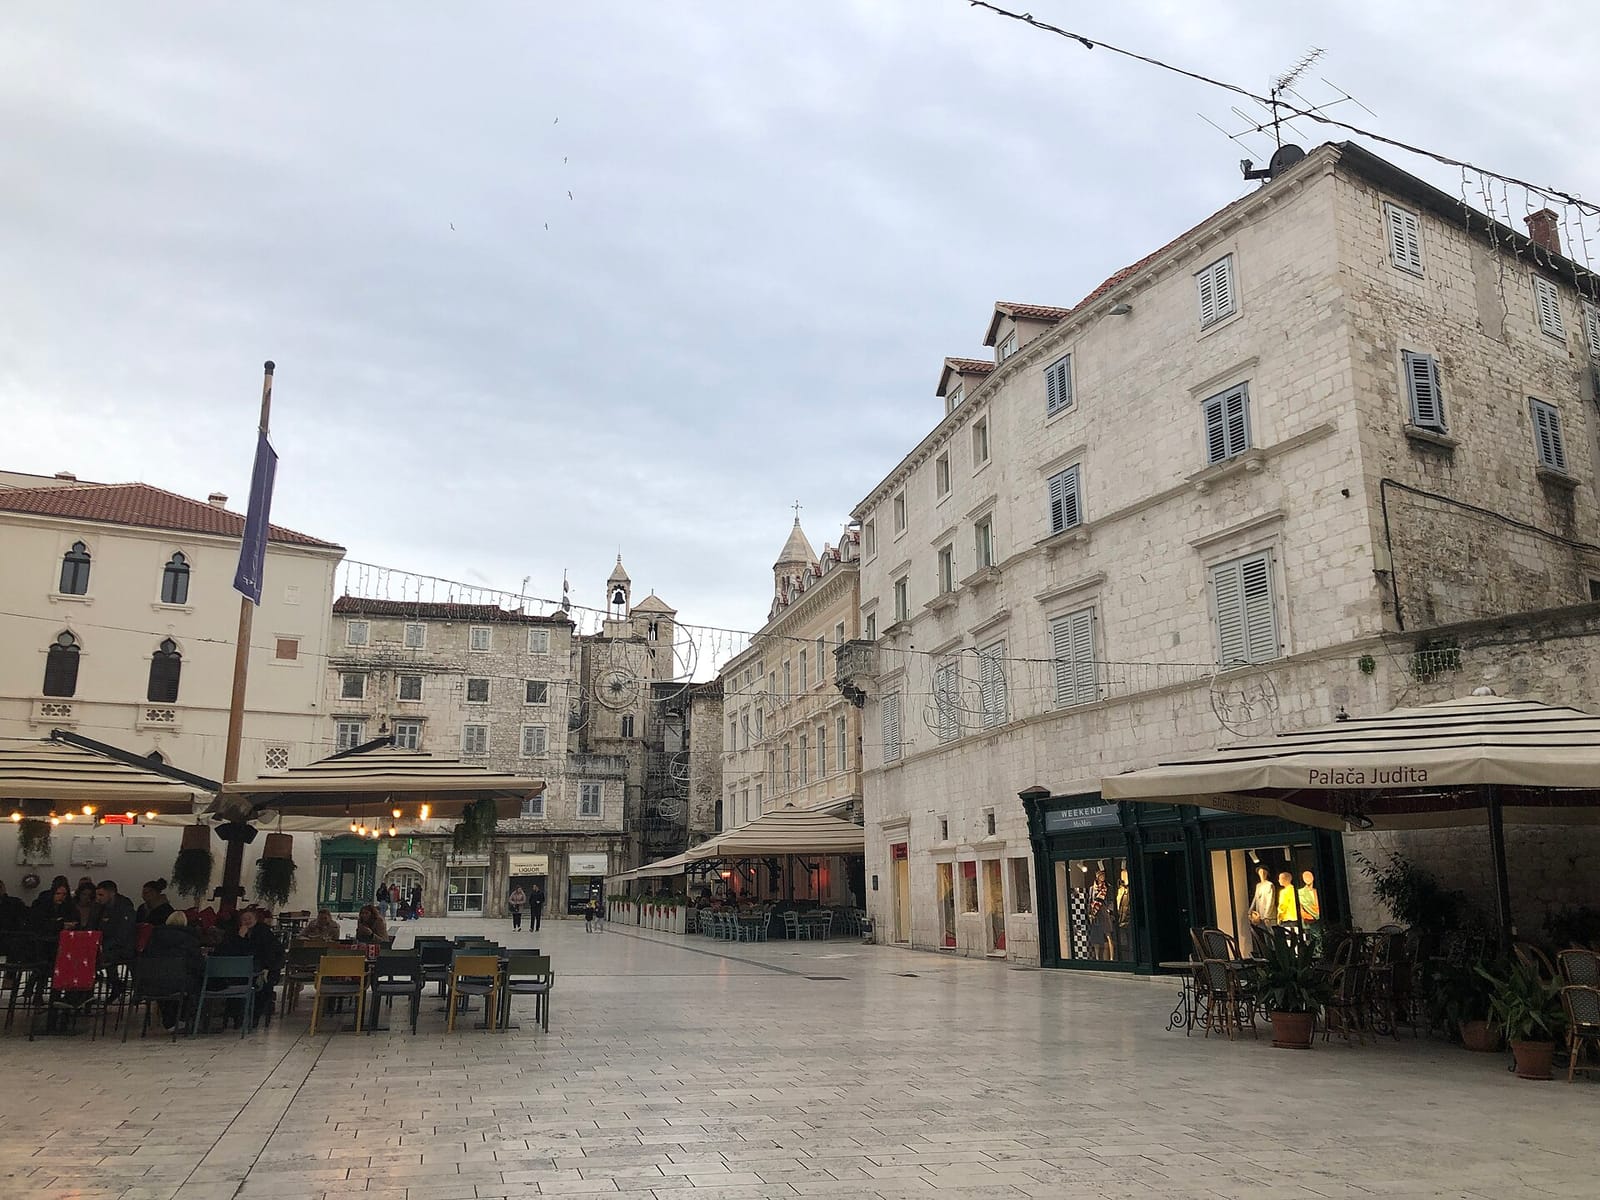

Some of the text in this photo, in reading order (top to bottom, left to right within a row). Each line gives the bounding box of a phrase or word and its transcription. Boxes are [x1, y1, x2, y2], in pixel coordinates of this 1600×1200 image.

[1309, 766, 1428, 785] Palača Judita
[1061, 806, 1103, 818] WEEKEND
